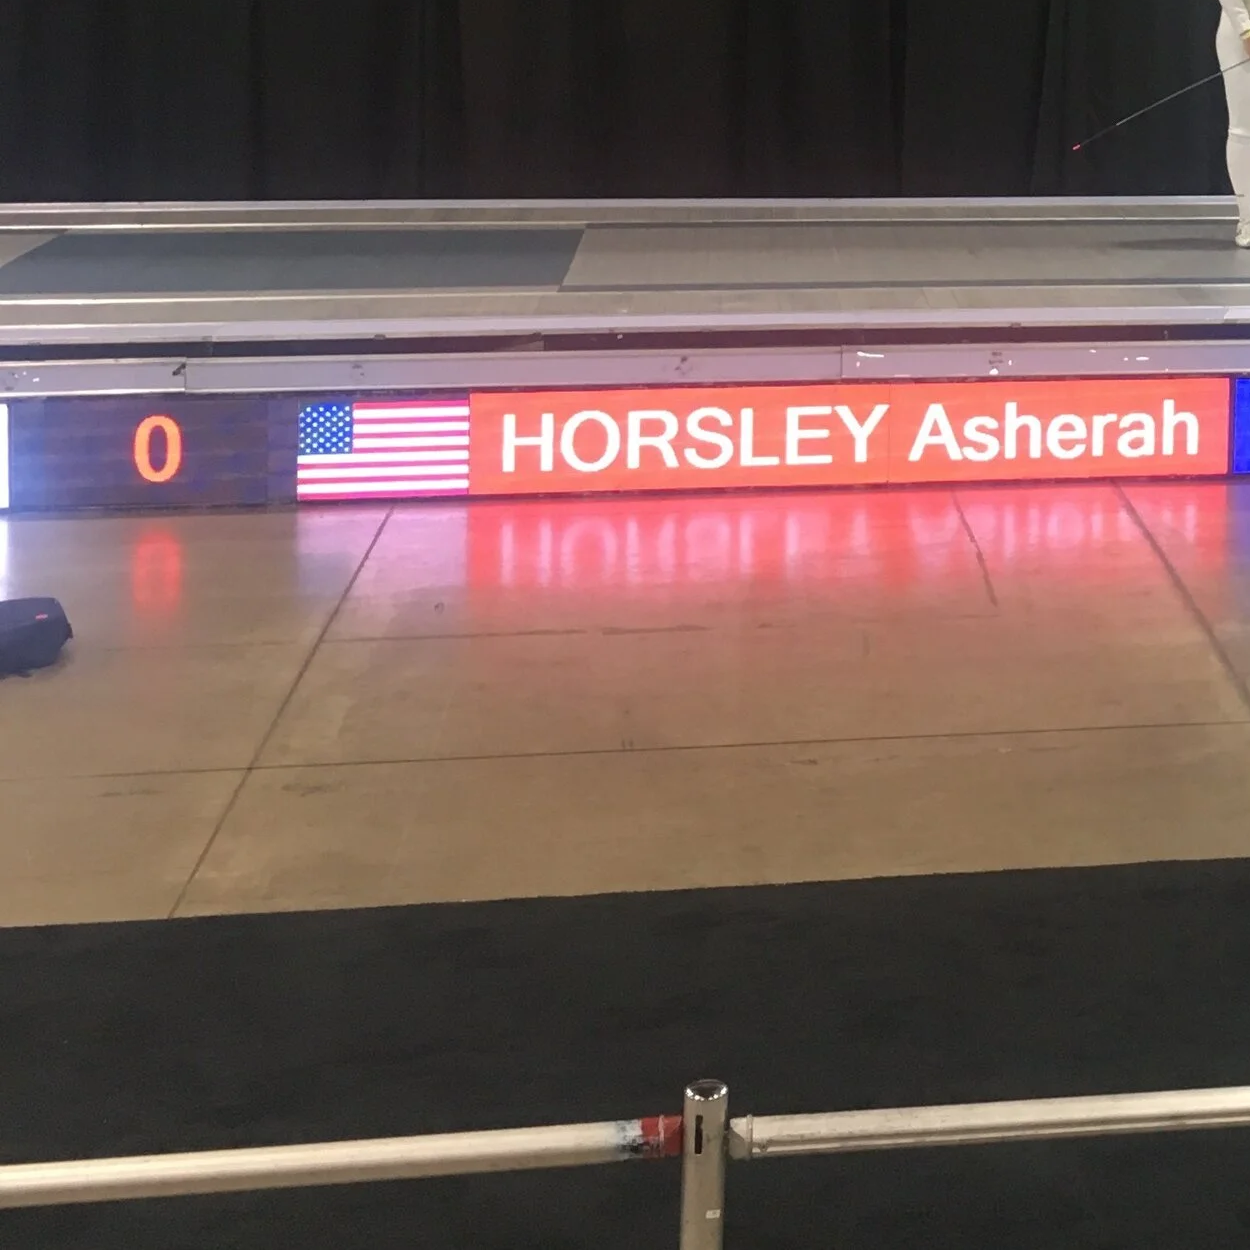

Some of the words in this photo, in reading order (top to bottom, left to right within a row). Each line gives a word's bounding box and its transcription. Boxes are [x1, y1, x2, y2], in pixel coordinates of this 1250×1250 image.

[133, 414, 183, 483] 0
[501, 404, 890, 473] HORSLEY
[909, 399, 1200, 463] Asherah
